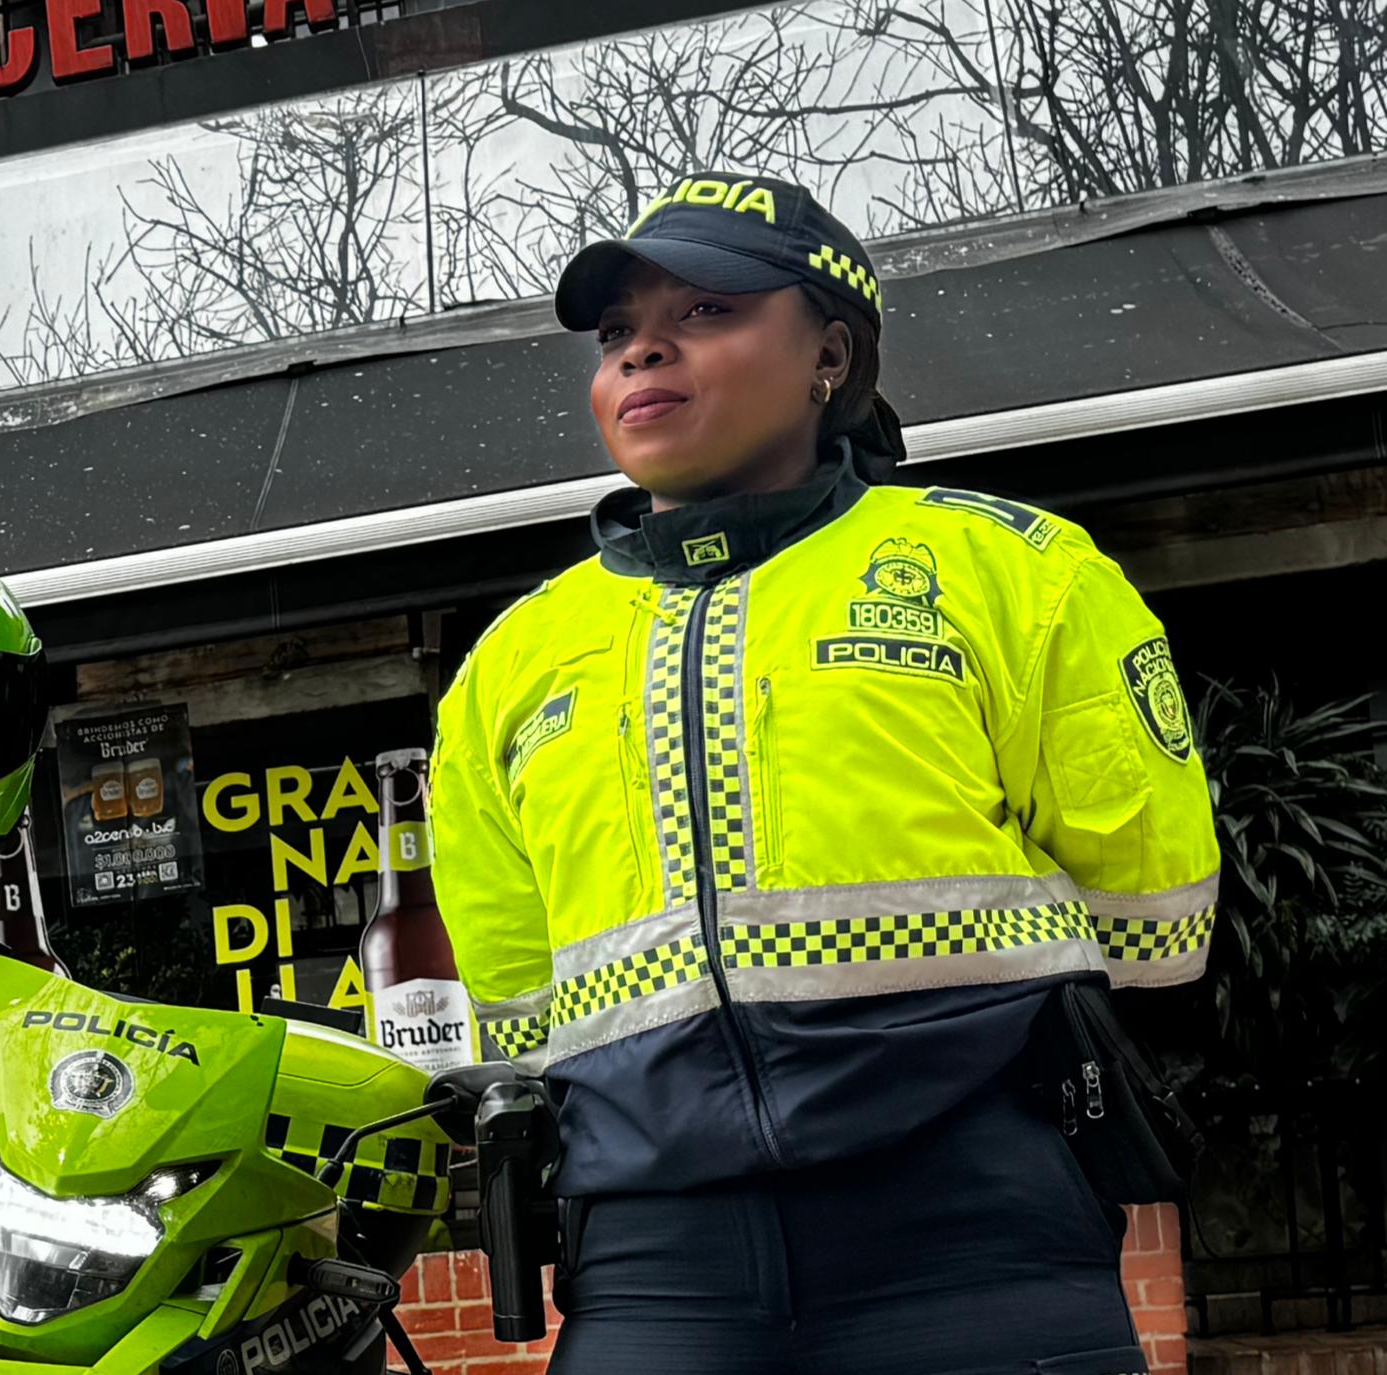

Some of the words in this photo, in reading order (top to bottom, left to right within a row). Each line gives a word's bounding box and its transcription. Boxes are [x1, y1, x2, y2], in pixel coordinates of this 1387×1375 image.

[851, 603, 935, 635] 180359
[828, 642, 957, 676] POLICÍA
[202, 755, 381, 832] GRA
[270, 820, 381, 892] NA
[212, 898, 293, 965] DI
[22, 1010, 201, 1067] POLICÍA
[380, 1018, 466, 1049] Bruder
